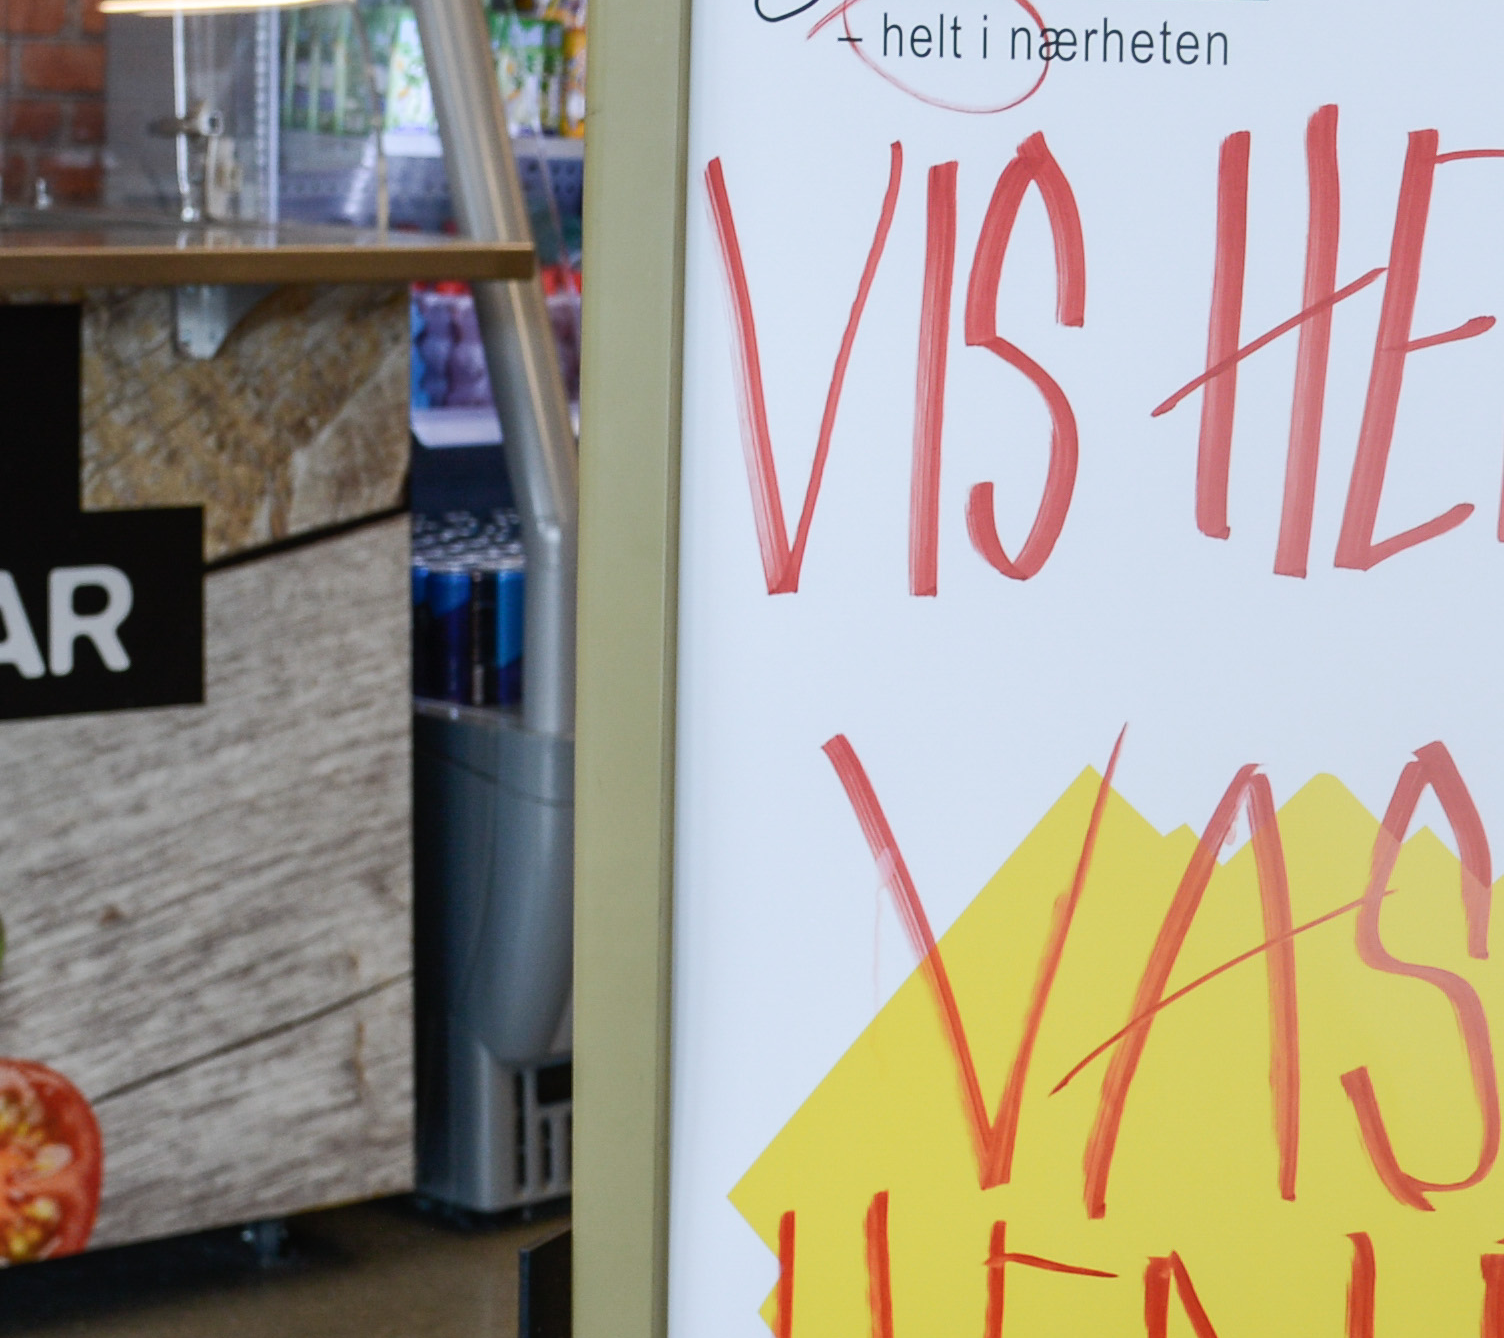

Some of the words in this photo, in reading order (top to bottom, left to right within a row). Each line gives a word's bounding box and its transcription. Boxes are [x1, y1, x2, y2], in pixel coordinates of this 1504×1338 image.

[882, 13, 962, 60] helt
[1010, 18, 1230, 66] nærheten
[708, 129, 1086, 597] VIS
